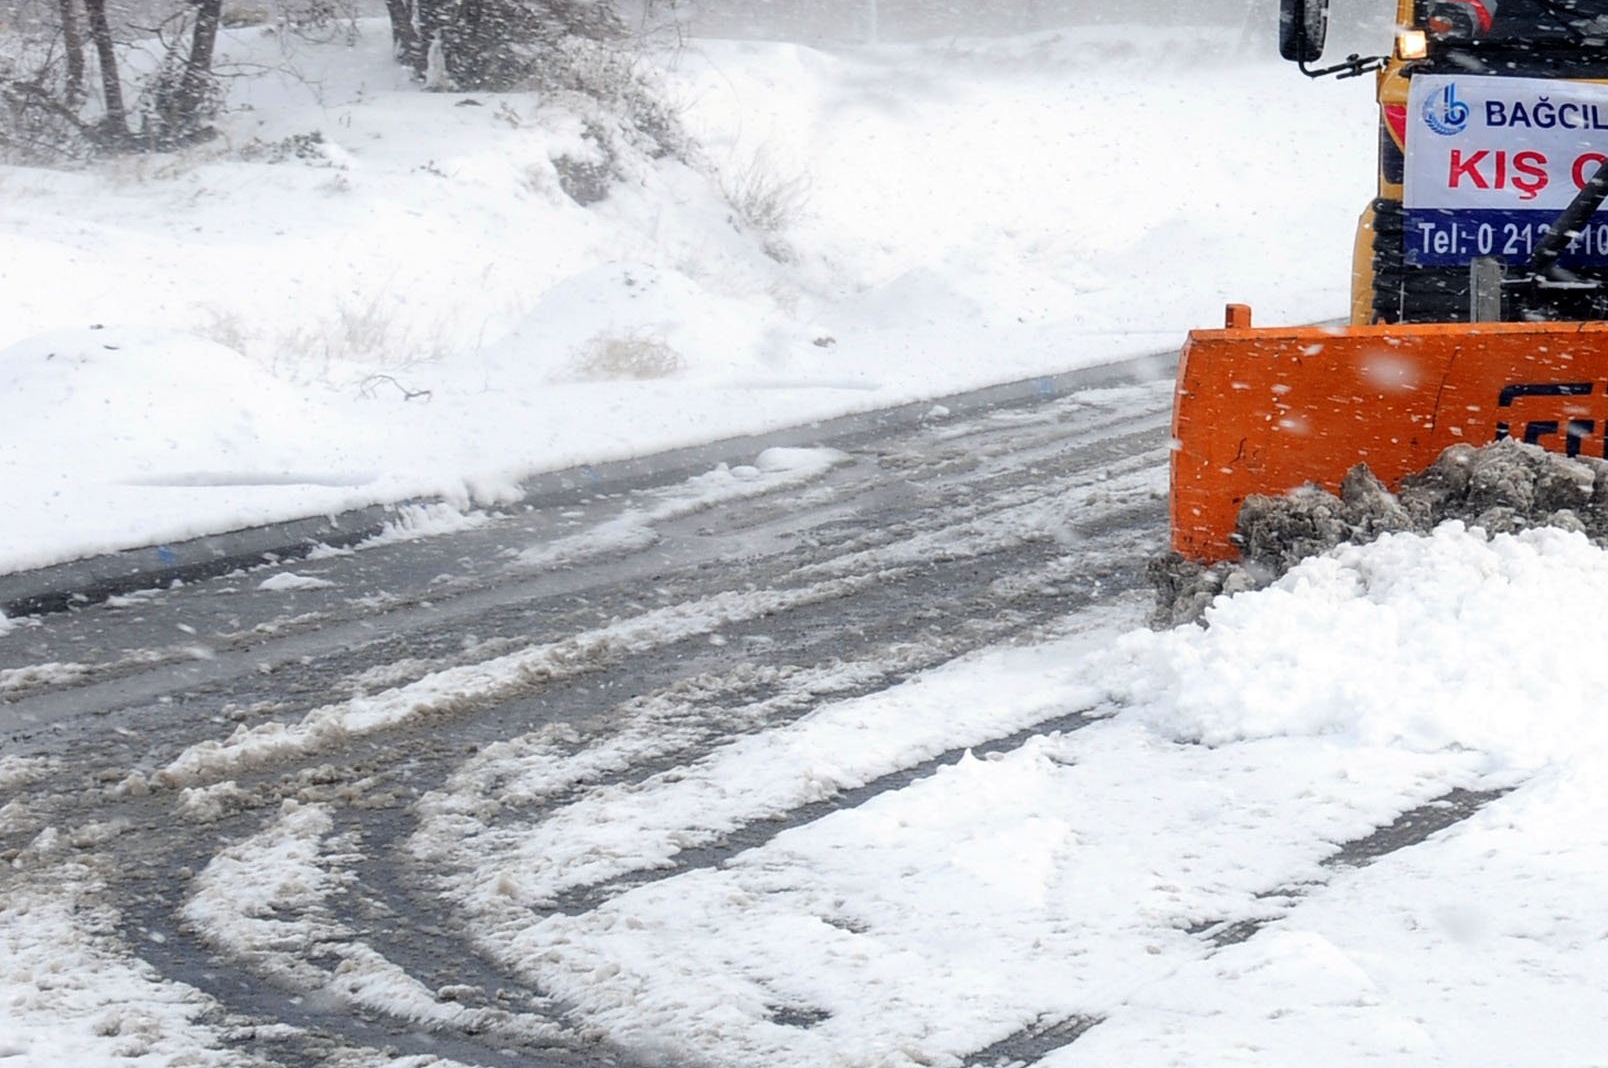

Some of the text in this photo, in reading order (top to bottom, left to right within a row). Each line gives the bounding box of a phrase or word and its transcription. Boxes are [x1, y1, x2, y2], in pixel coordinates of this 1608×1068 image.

[1447, 149, 1549, 200] KIŞ
[1418, 222, 1467, 254] Tel:
[1477, 223, 1493, 254] 0
